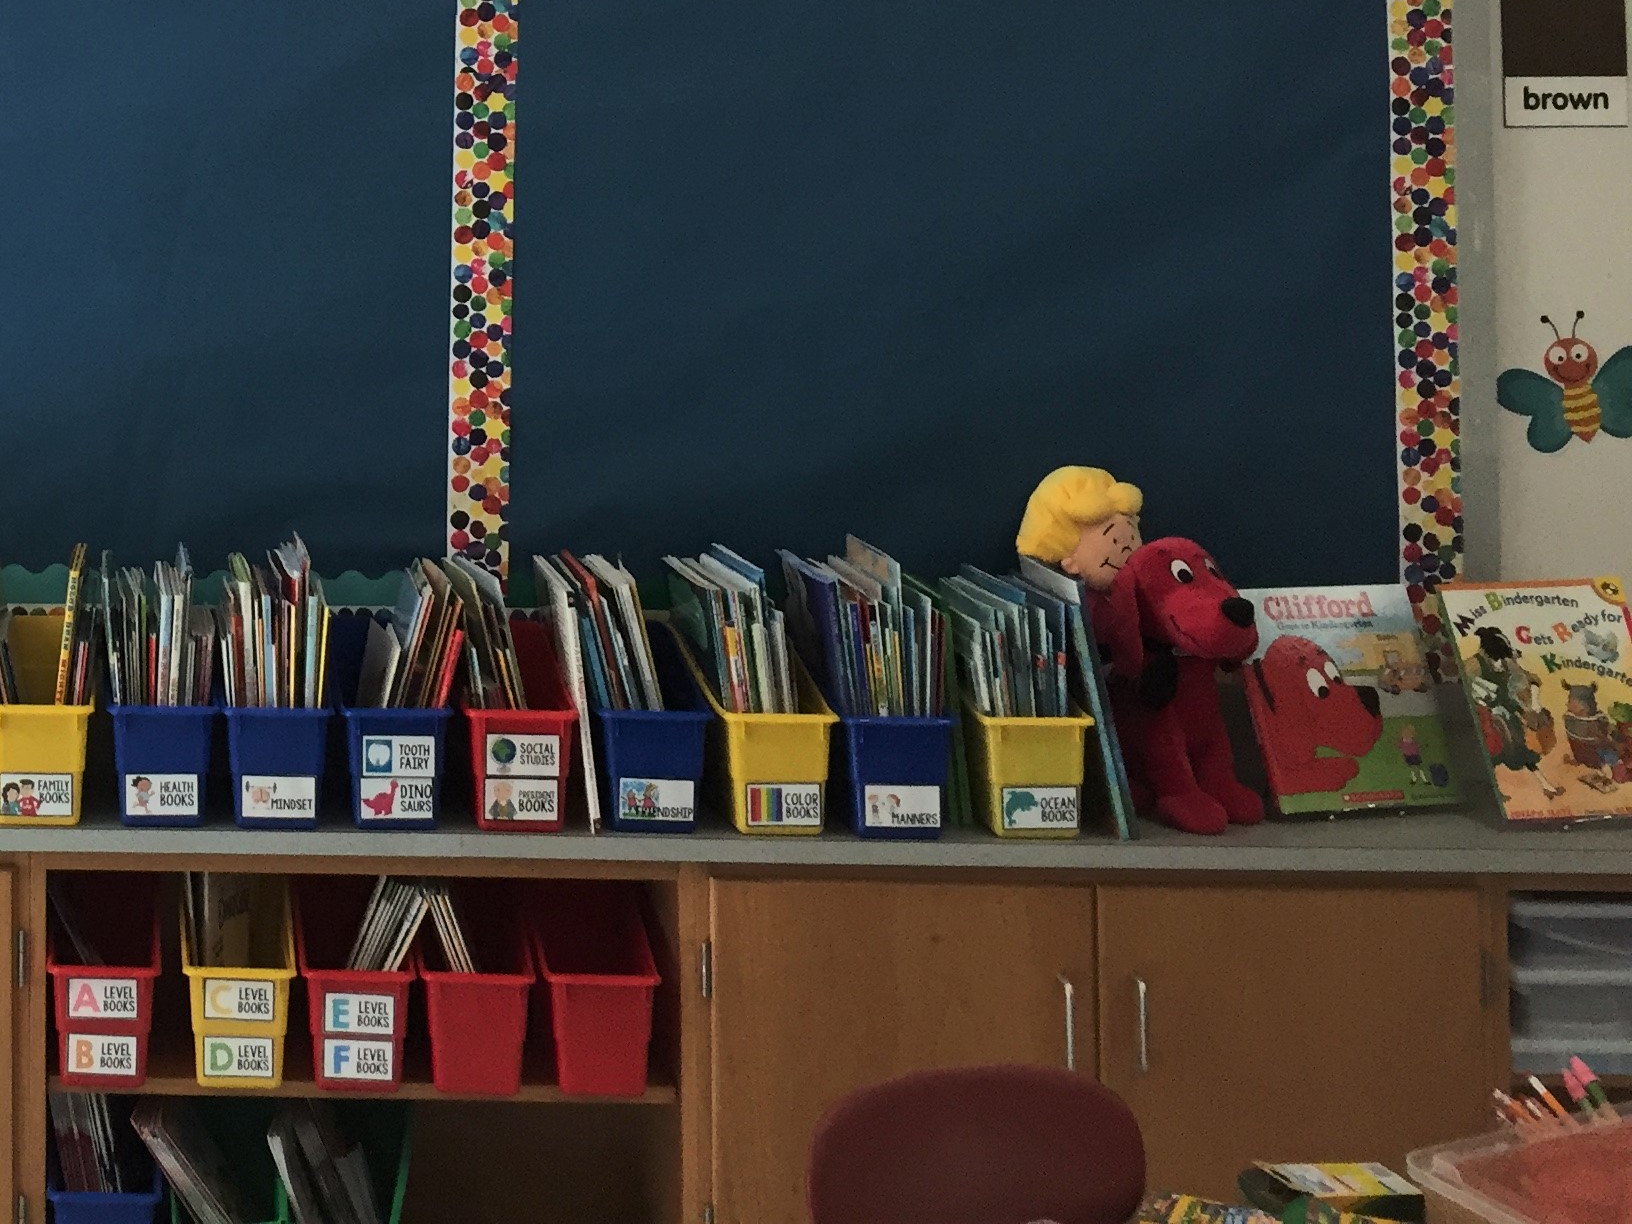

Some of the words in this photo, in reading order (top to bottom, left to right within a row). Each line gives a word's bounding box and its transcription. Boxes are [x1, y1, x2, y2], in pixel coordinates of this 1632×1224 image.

[1523, 85, 1610, 110] brown
[1263, 591, 1376, 622] Clifford
[1453, 605, 1487, 637] Miss
[1485, 592, 1578, 611] Bindergarten
[1515, 626, 1554, 645] Gets
[1552, 613, 1599, 643] Ready
[1601, 609, 1622, 623] for
[1540, 652, 1632, 687] Kindergarte
[399, 744, 430, 756] TOOTH
[520, 743, 554, 755] SOCIAL
[399, 757, 429, 769] FAIRY
[520, 755, 555, 765] STUDIES
[38, 780, 69, 791] FAMILY
[160, 782, 193, 793] HEALTH
[400, 784, 431, 799] DINO
[39, 792, 70, 804] BOOKS
[160, 794, 194, 806] BOOKS
[271, 798, 312, 810] MINDSET
[785, 793, 818, 806] COLOR
[1040, 797, 1076, 810] OCEAN
[400, 800, 432, 812] SAURS
[519, 800, 554, 812] BOOKS
[635, 806, 693, 818] FRIENDSHIP
[785, 806, 819, 818] BOOKS
[891, 813, 938, 825] MANNERS
[1041, 810, 1076, 822] BOOKS
[72, 983, 102, 1012] A
[104, 986, 134, 999] LEVEL
[210, 985, 232, 1014] C
[239, 987, 269, 1000] LEVEL
[103, 1000, 135, 1012] BOOKS
[238, 1002, 270, 1014] BOOKS
[332, 998, 350, 1029] E
[358, 1001, 389, 1014] LEVEL
[357, 1015, 390, 1028] BOOKS
[76, 1040, 95, 1069] B
[101, 1043, 131, 1056] LEVEL
[210, 1043, 233, 1071] D
[238, 1045, 268, 1058] LEVEL
[333, 1046, 350, 1074] F
[357, 1048, 387, 1061] LEVEL
[100, 1057, 132, 1069] BOOKS
[237, 1059, 269, 1071] BOOKS
[356, 1062, 388, 1075] BOOKS
